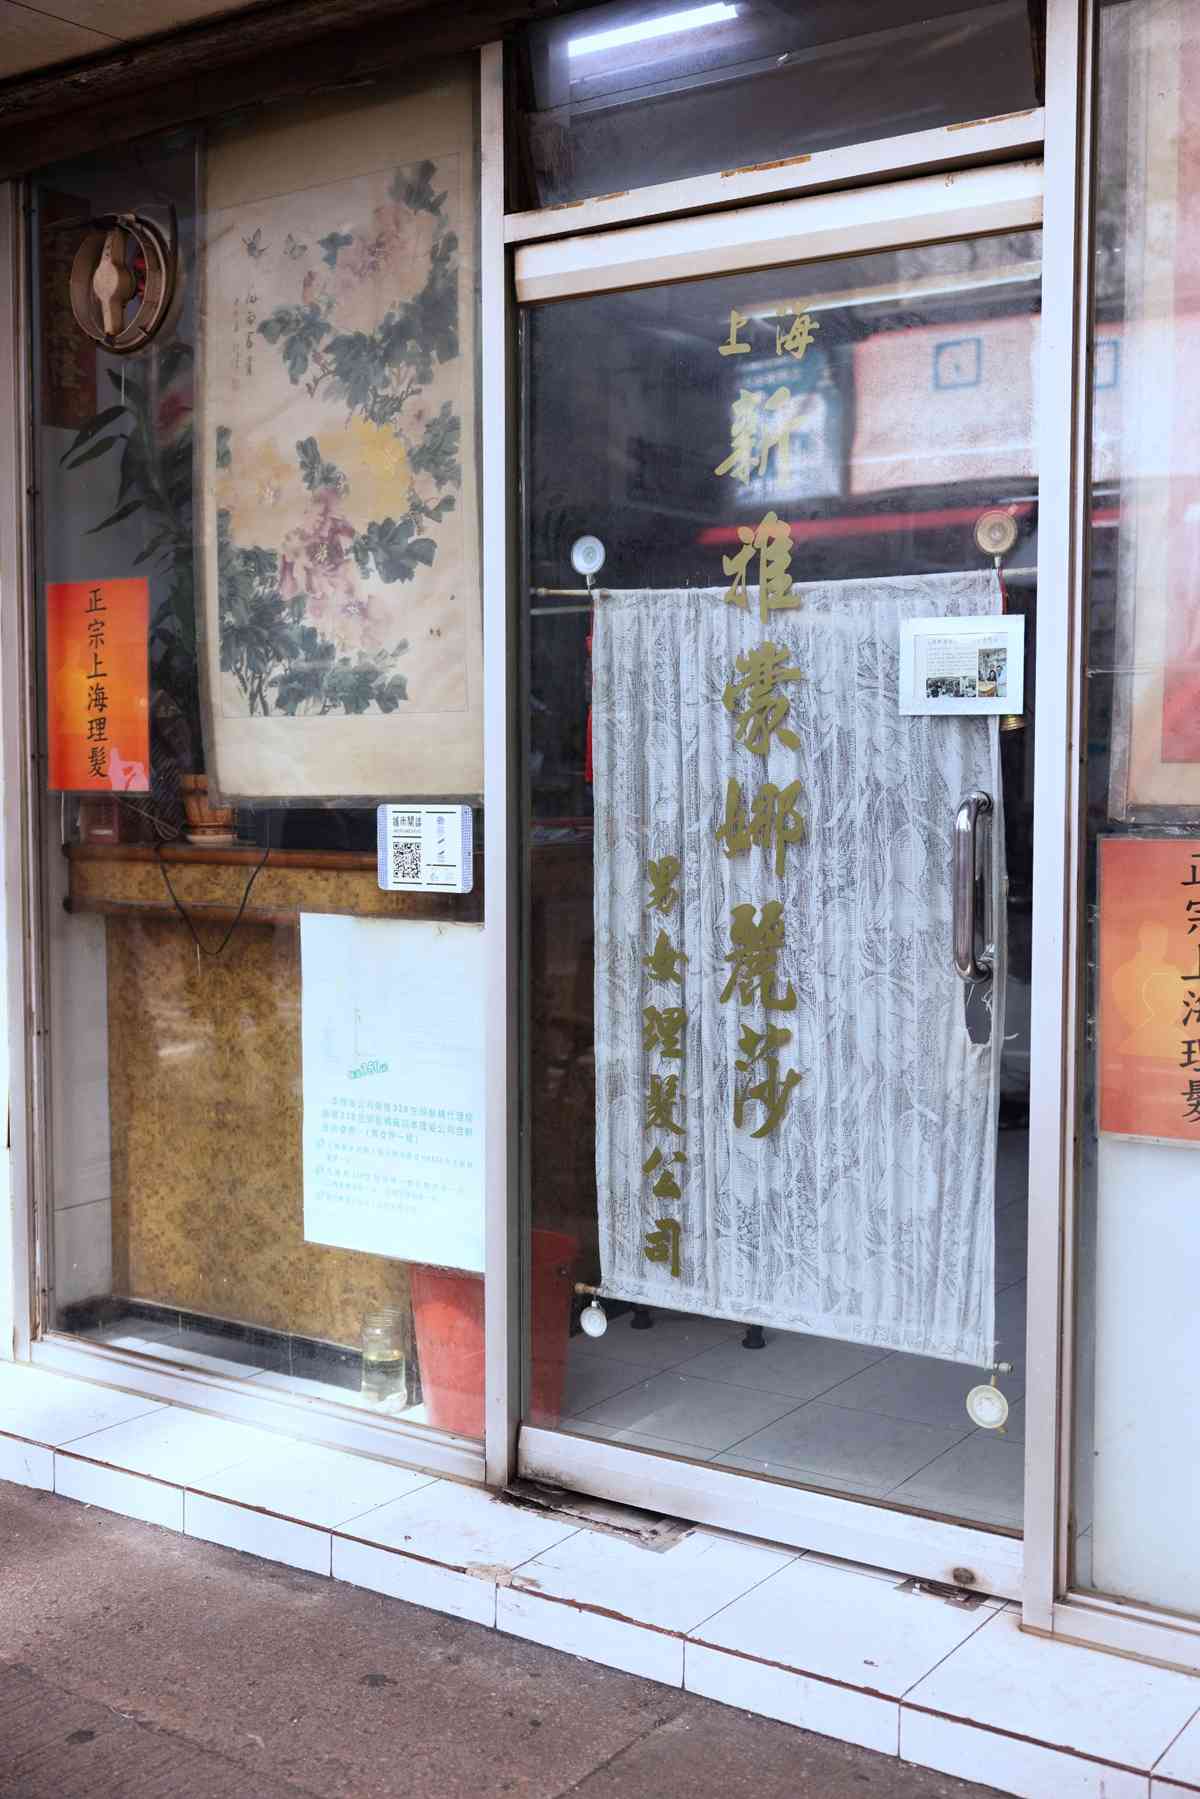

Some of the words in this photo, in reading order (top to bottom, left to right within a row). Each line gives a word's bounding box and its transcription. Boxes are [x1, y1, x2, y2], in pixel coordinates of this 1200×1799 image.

[718, 304, 820, 359] 上海
[86, 588, 109, 778] 正宗上海理髮
